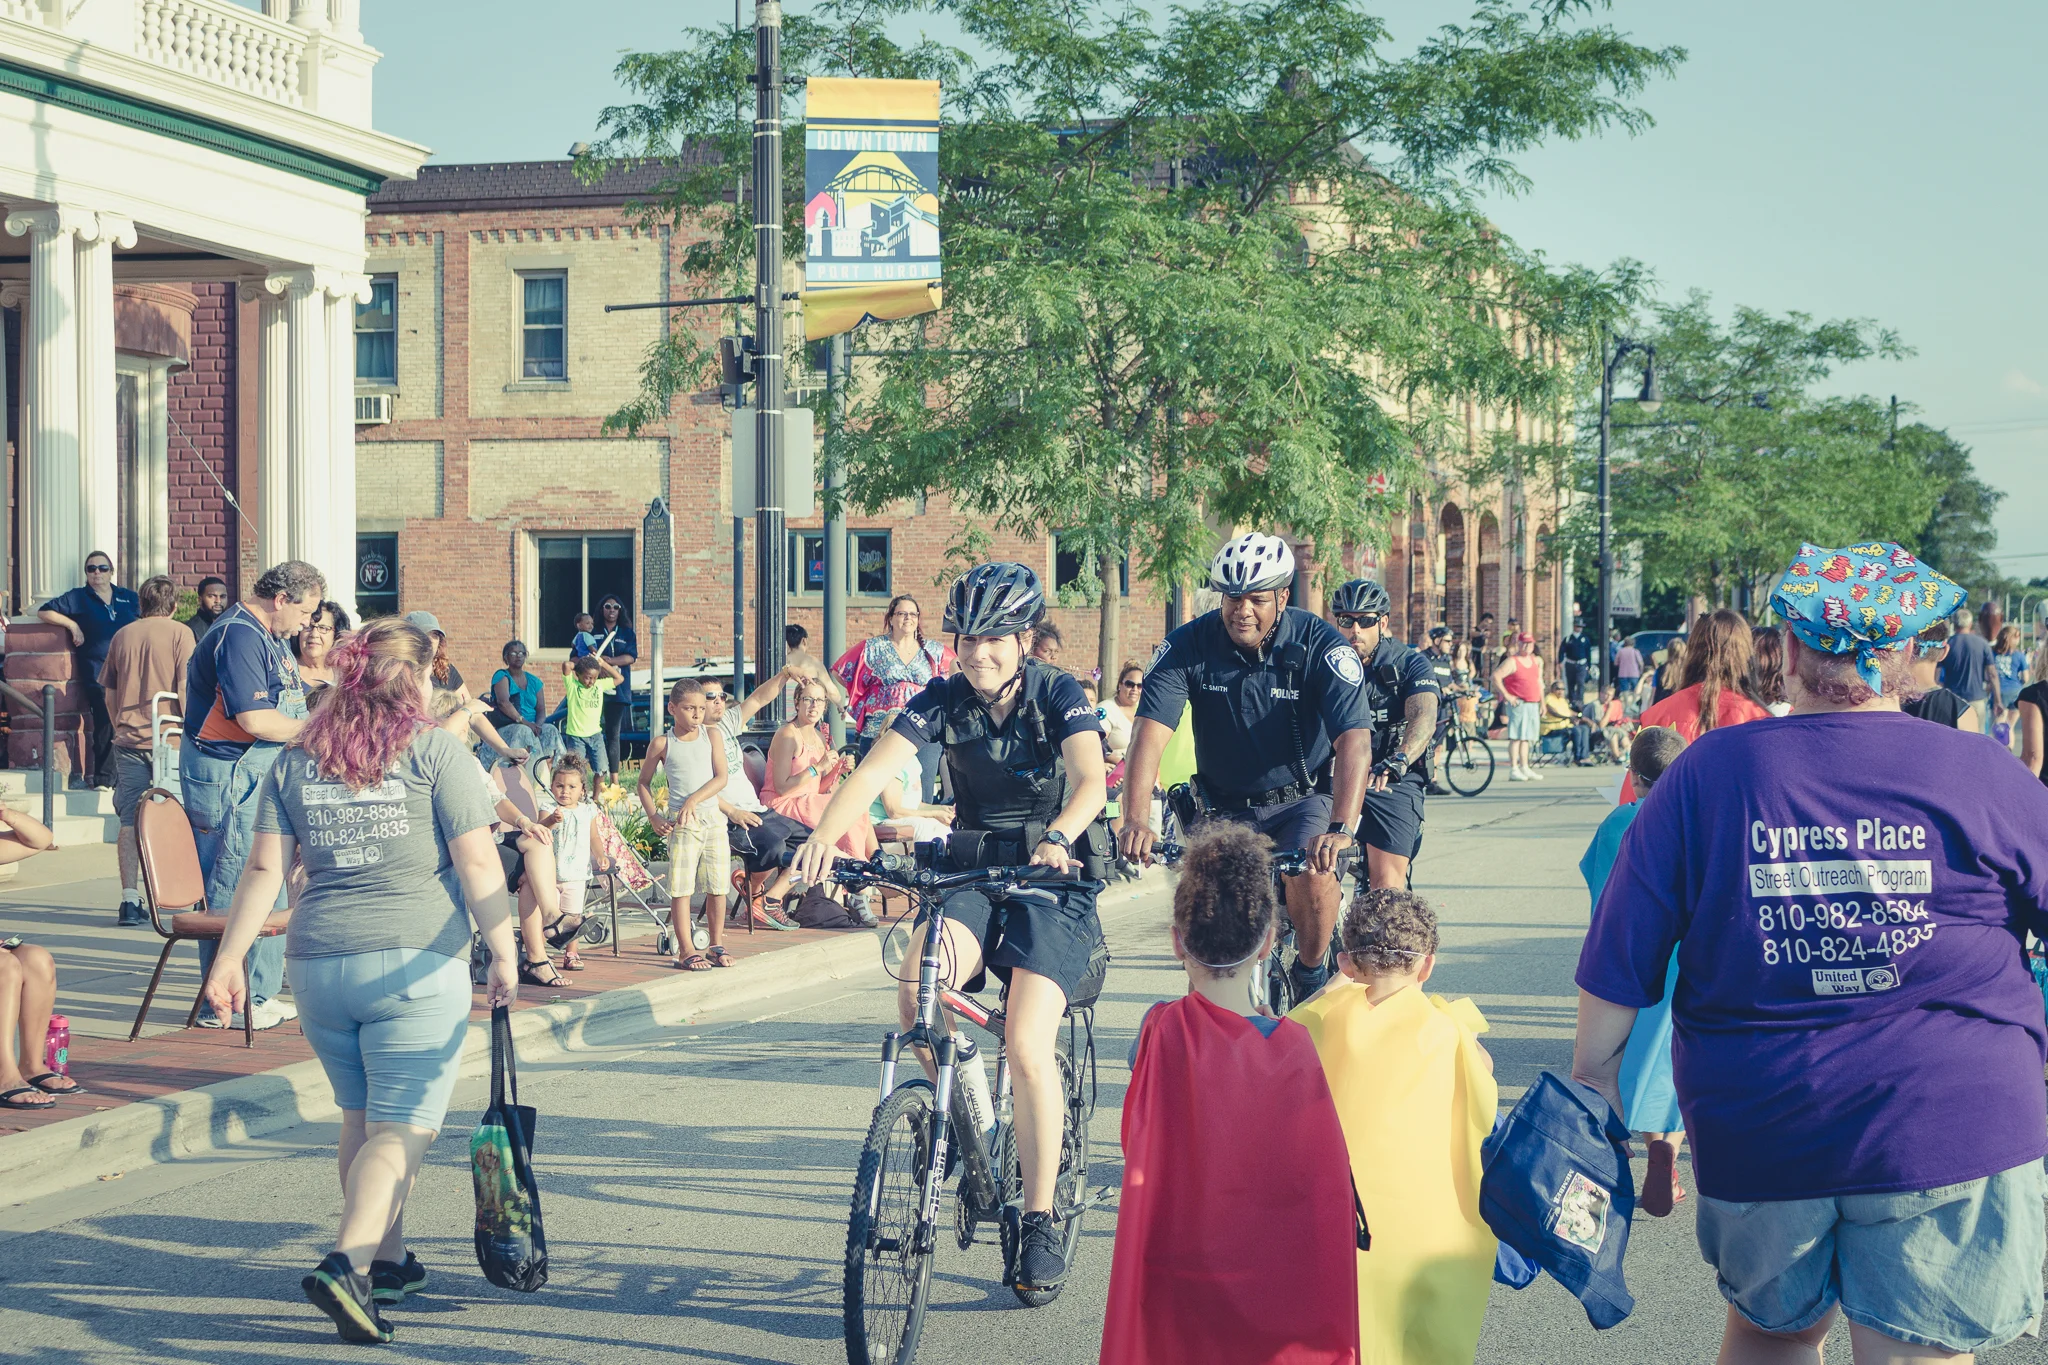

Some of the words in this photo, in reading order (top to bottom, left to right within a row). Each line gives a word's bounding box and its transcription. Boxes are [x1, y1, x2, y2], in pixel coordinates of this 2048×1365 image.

[817, 130, 928, 152] DOWNTOWN
[817, 264, 859, 279] PORT
[873, 263, 930, 279] HURON
[902, 707, 927, 729] LICE
[305, 787, 329, 800] Street
[306, 802, 408, 826] 810-982-8584
[309, 819, 410, 847] 810-824-4835
[1751, 820, 1849, 859] Cypress
[1856, 817, 1926, 850] Place
[334, 848, 361, 857] United
[345, 857, 362, 865] Way
[1754, 866, 1797, 889] Street
[1800, 864, 1863, 888] Outreach
[1867, 865, 1927, 891] Program
[1758, 899, 1929, 931] 810-982-8584
[1763, 922, 1937, 965] 810-824-4835
[1814, 970, 1858, 982] United
[1831, 984, 1860, 994] Way
[1553, 1168, 1574, 1204] MEMBER
